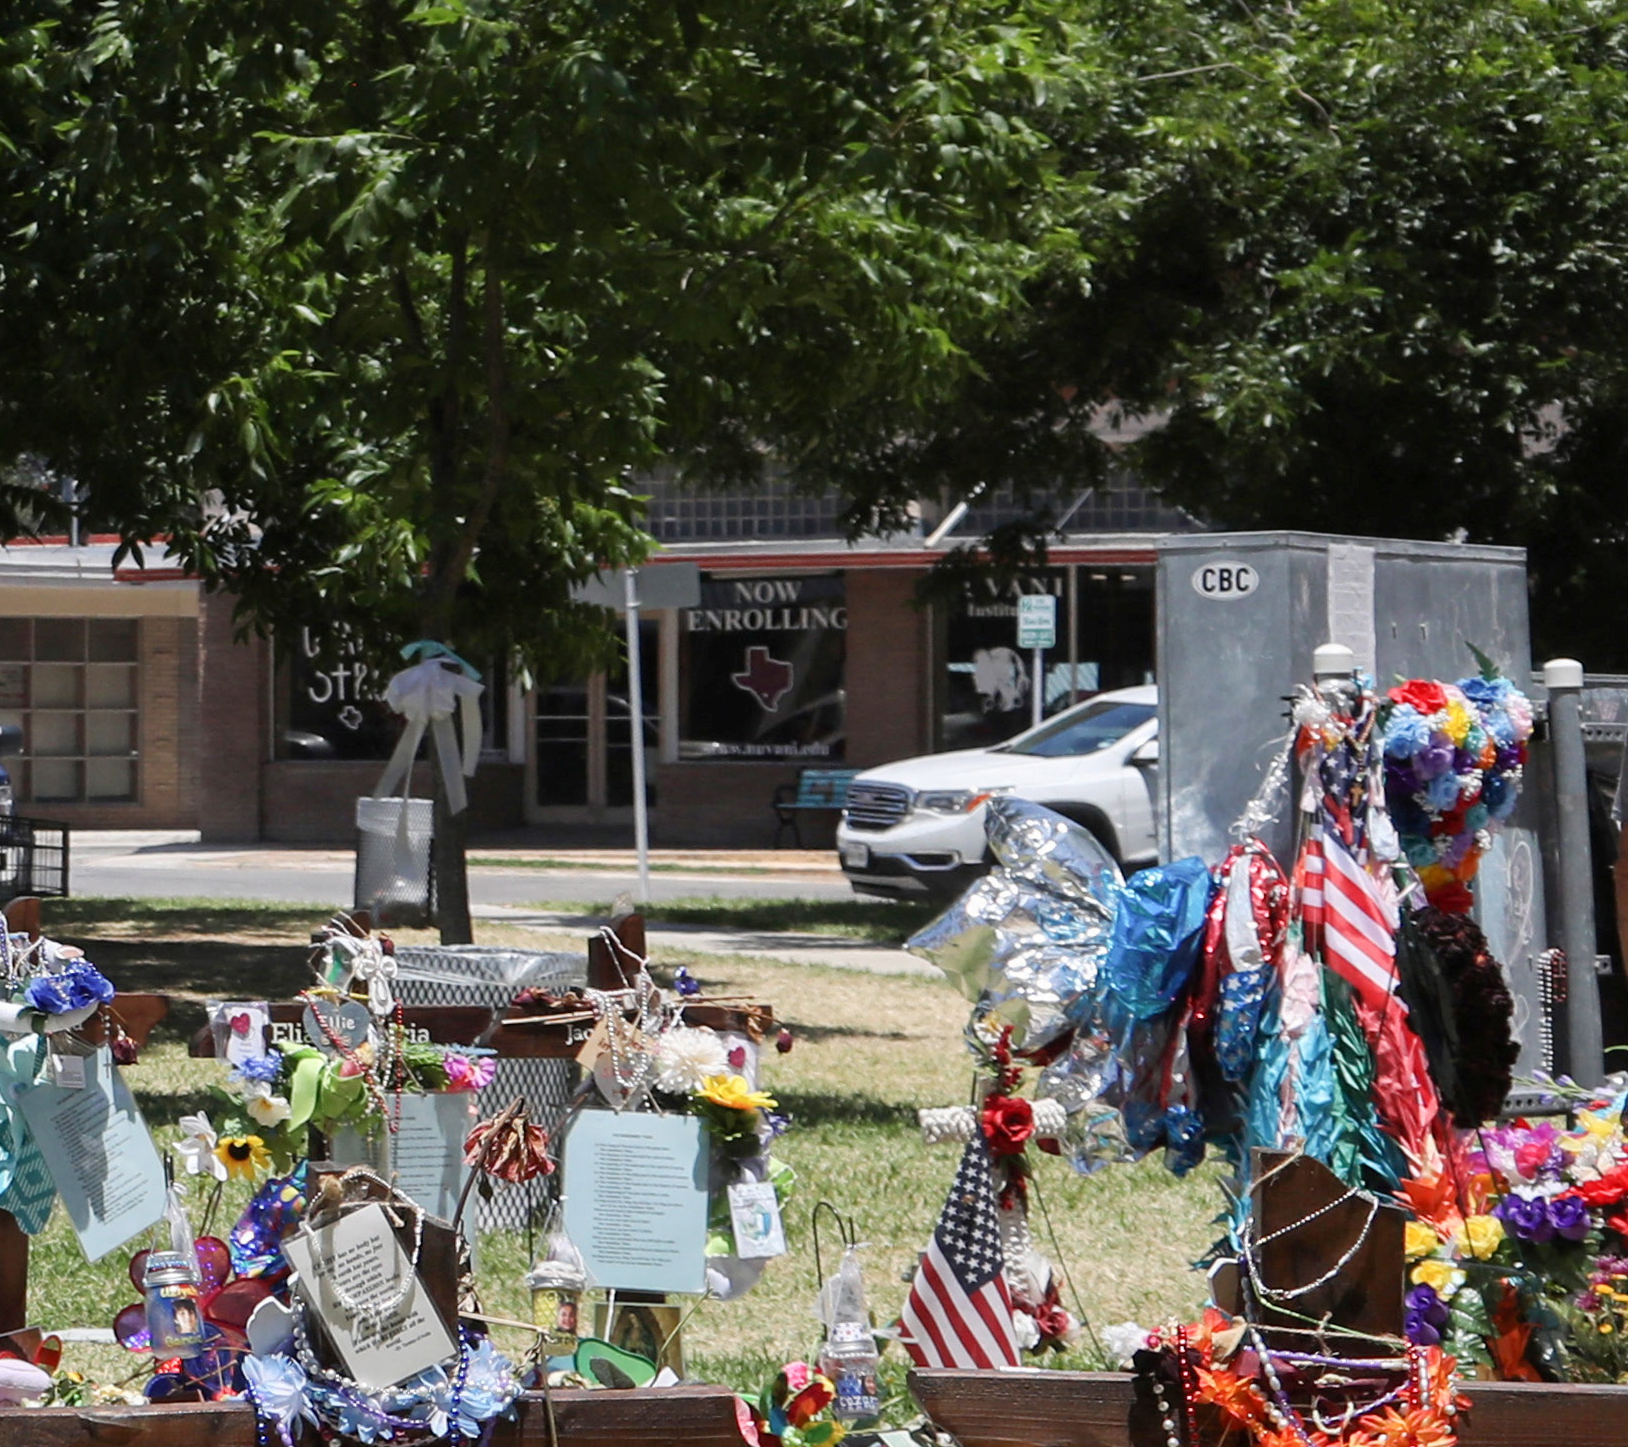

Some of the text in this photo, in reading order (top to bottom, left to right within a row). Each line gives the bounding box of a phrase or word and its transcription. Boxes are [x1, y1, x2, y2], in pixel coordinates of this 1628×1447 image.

[734, 580, 803, 603] NOW
[1201, 567, 1253, 593] CBC
[687, 606, 849, 632] ENROLLING
